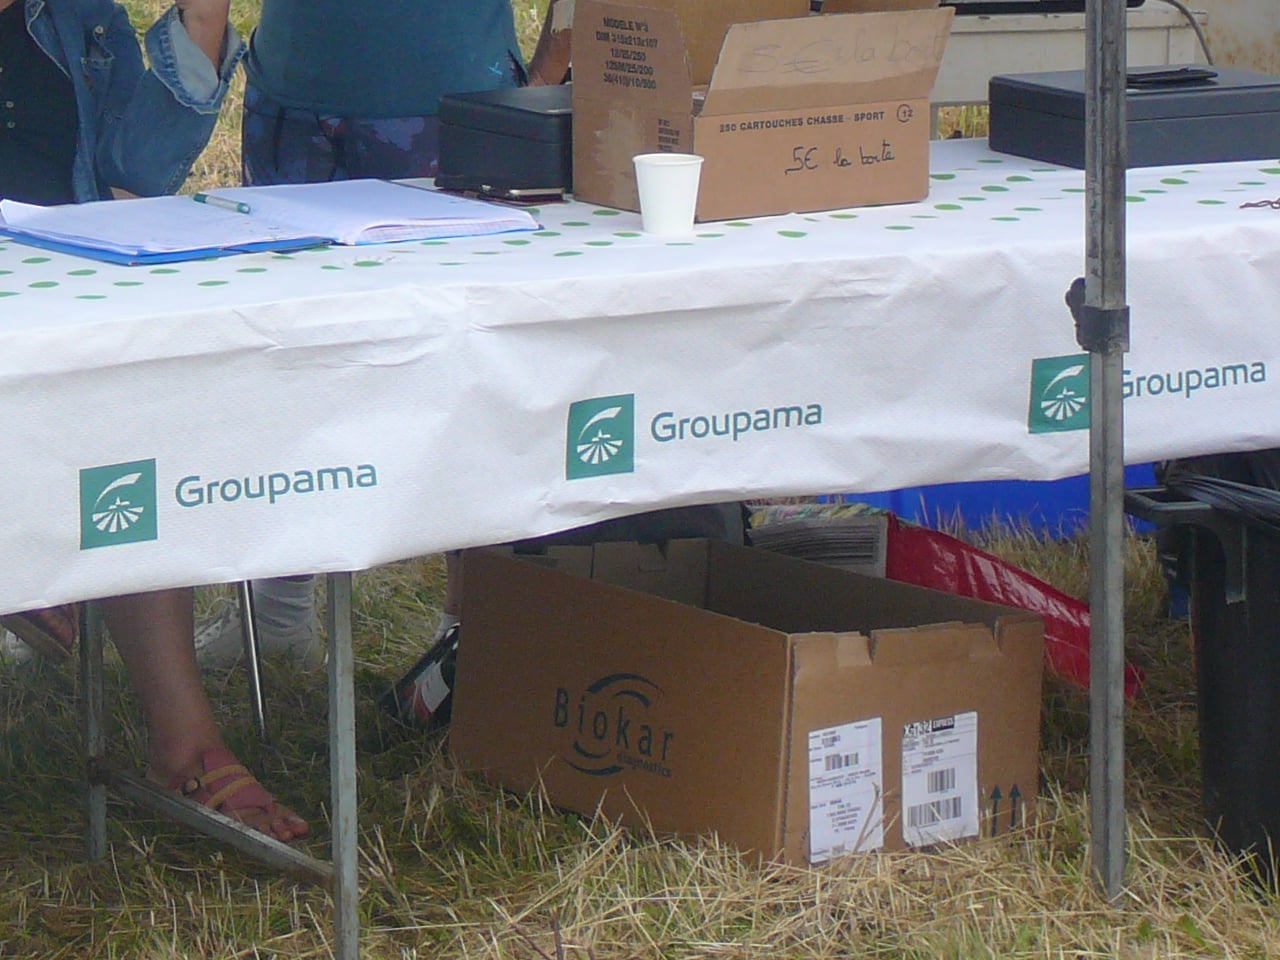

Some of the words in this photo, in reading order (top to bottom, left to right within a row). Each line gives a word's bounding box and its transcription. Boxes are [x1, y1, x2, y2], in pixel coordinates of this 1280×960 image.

[740, 117, 804, 131] CARTOUCHES
[807, 113, 844, 125] CHASSE
[854, 111, 886, 122] SPORT
[833, 147, 852, 167] la
[650, 403, 823, 443] Groupama
[175, 463, 378, 508] Groupama
[554, 687, 675, 761] Biokar
